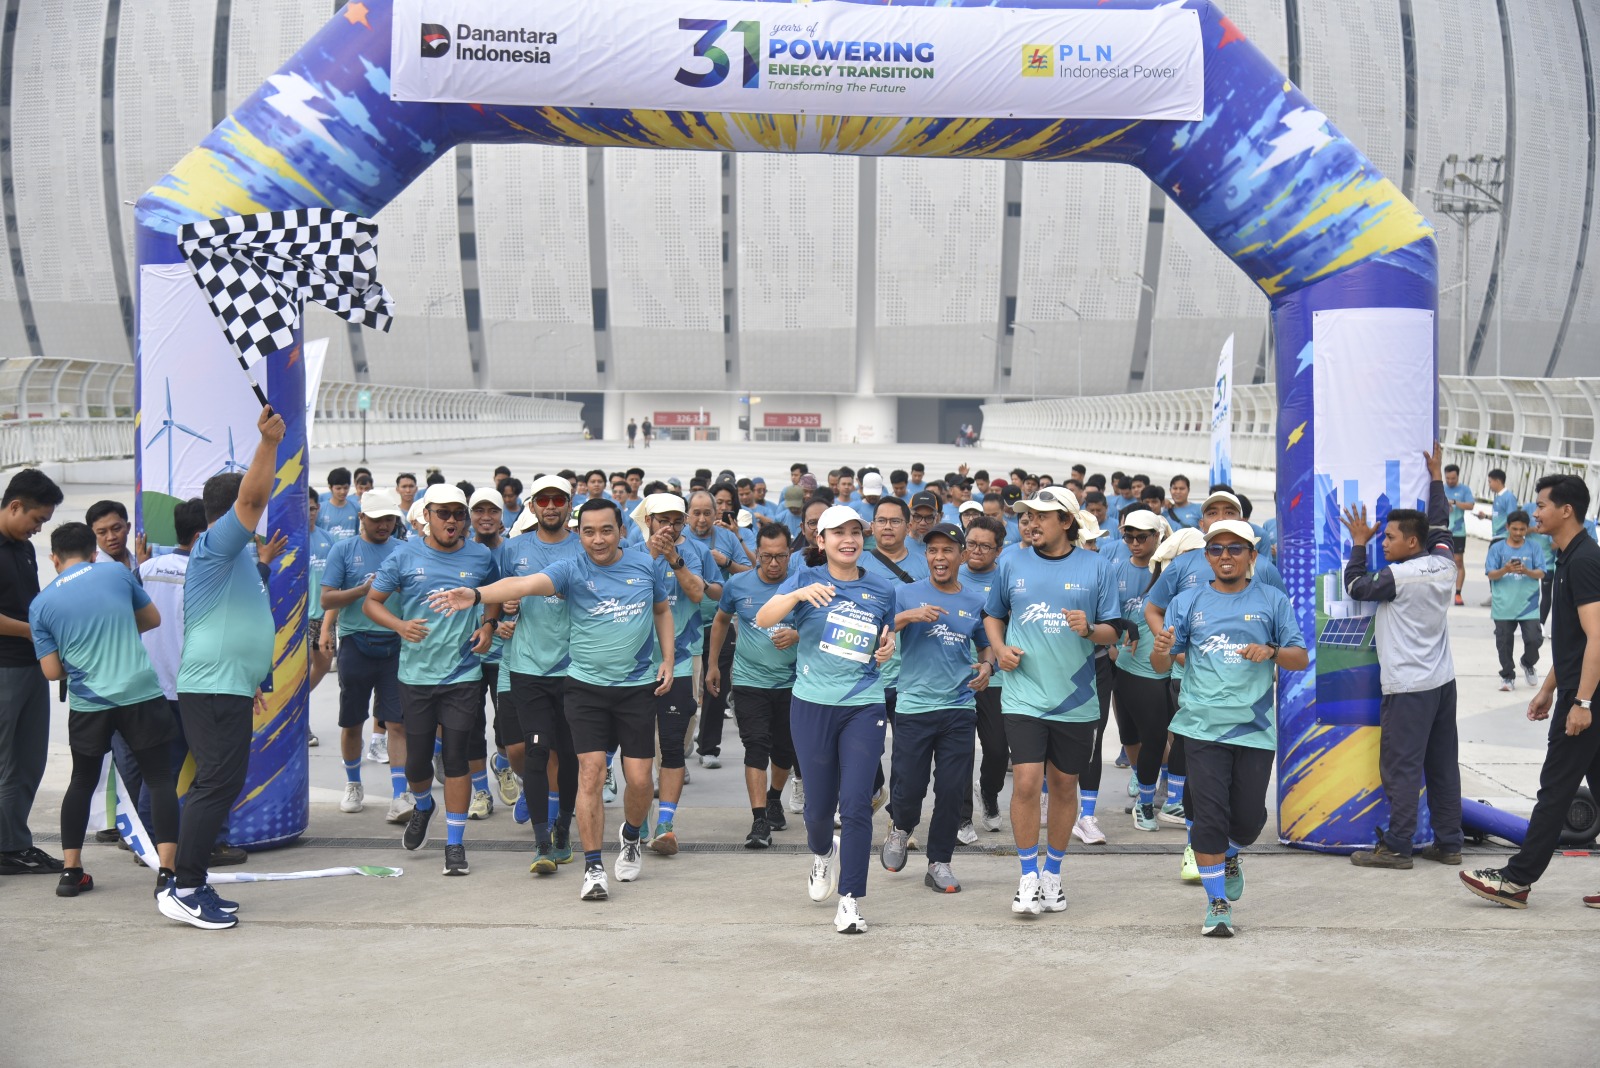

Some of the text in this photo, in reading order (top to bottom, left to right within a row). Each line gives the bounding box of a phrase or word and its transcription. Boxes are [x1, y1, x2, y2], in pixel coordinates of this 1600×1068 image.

[456, 23, 558, 45] Danantara
[769, 21, 820, 38] years of
[456, 44, 551, 65] Indonesia
[674, 17, 761, 89] 31
[768, 38, 935, 63] POWERING
[1059, 44, 1112, 62] PLN
[768, 63, 934, 79] ENERGY TRANSITION
[1060, 64, 1177, 79] Indonesia Power
[767, 80, 906, 94] Transforming The Future
[786, 415, 819, 425] 324-325
[1015, 578, 1025, 588] 31
[1043, 619, 1059, 627] FUN
[1043, 626, 1061, 634] 2026
[831, 627, 870, 648] IP005
